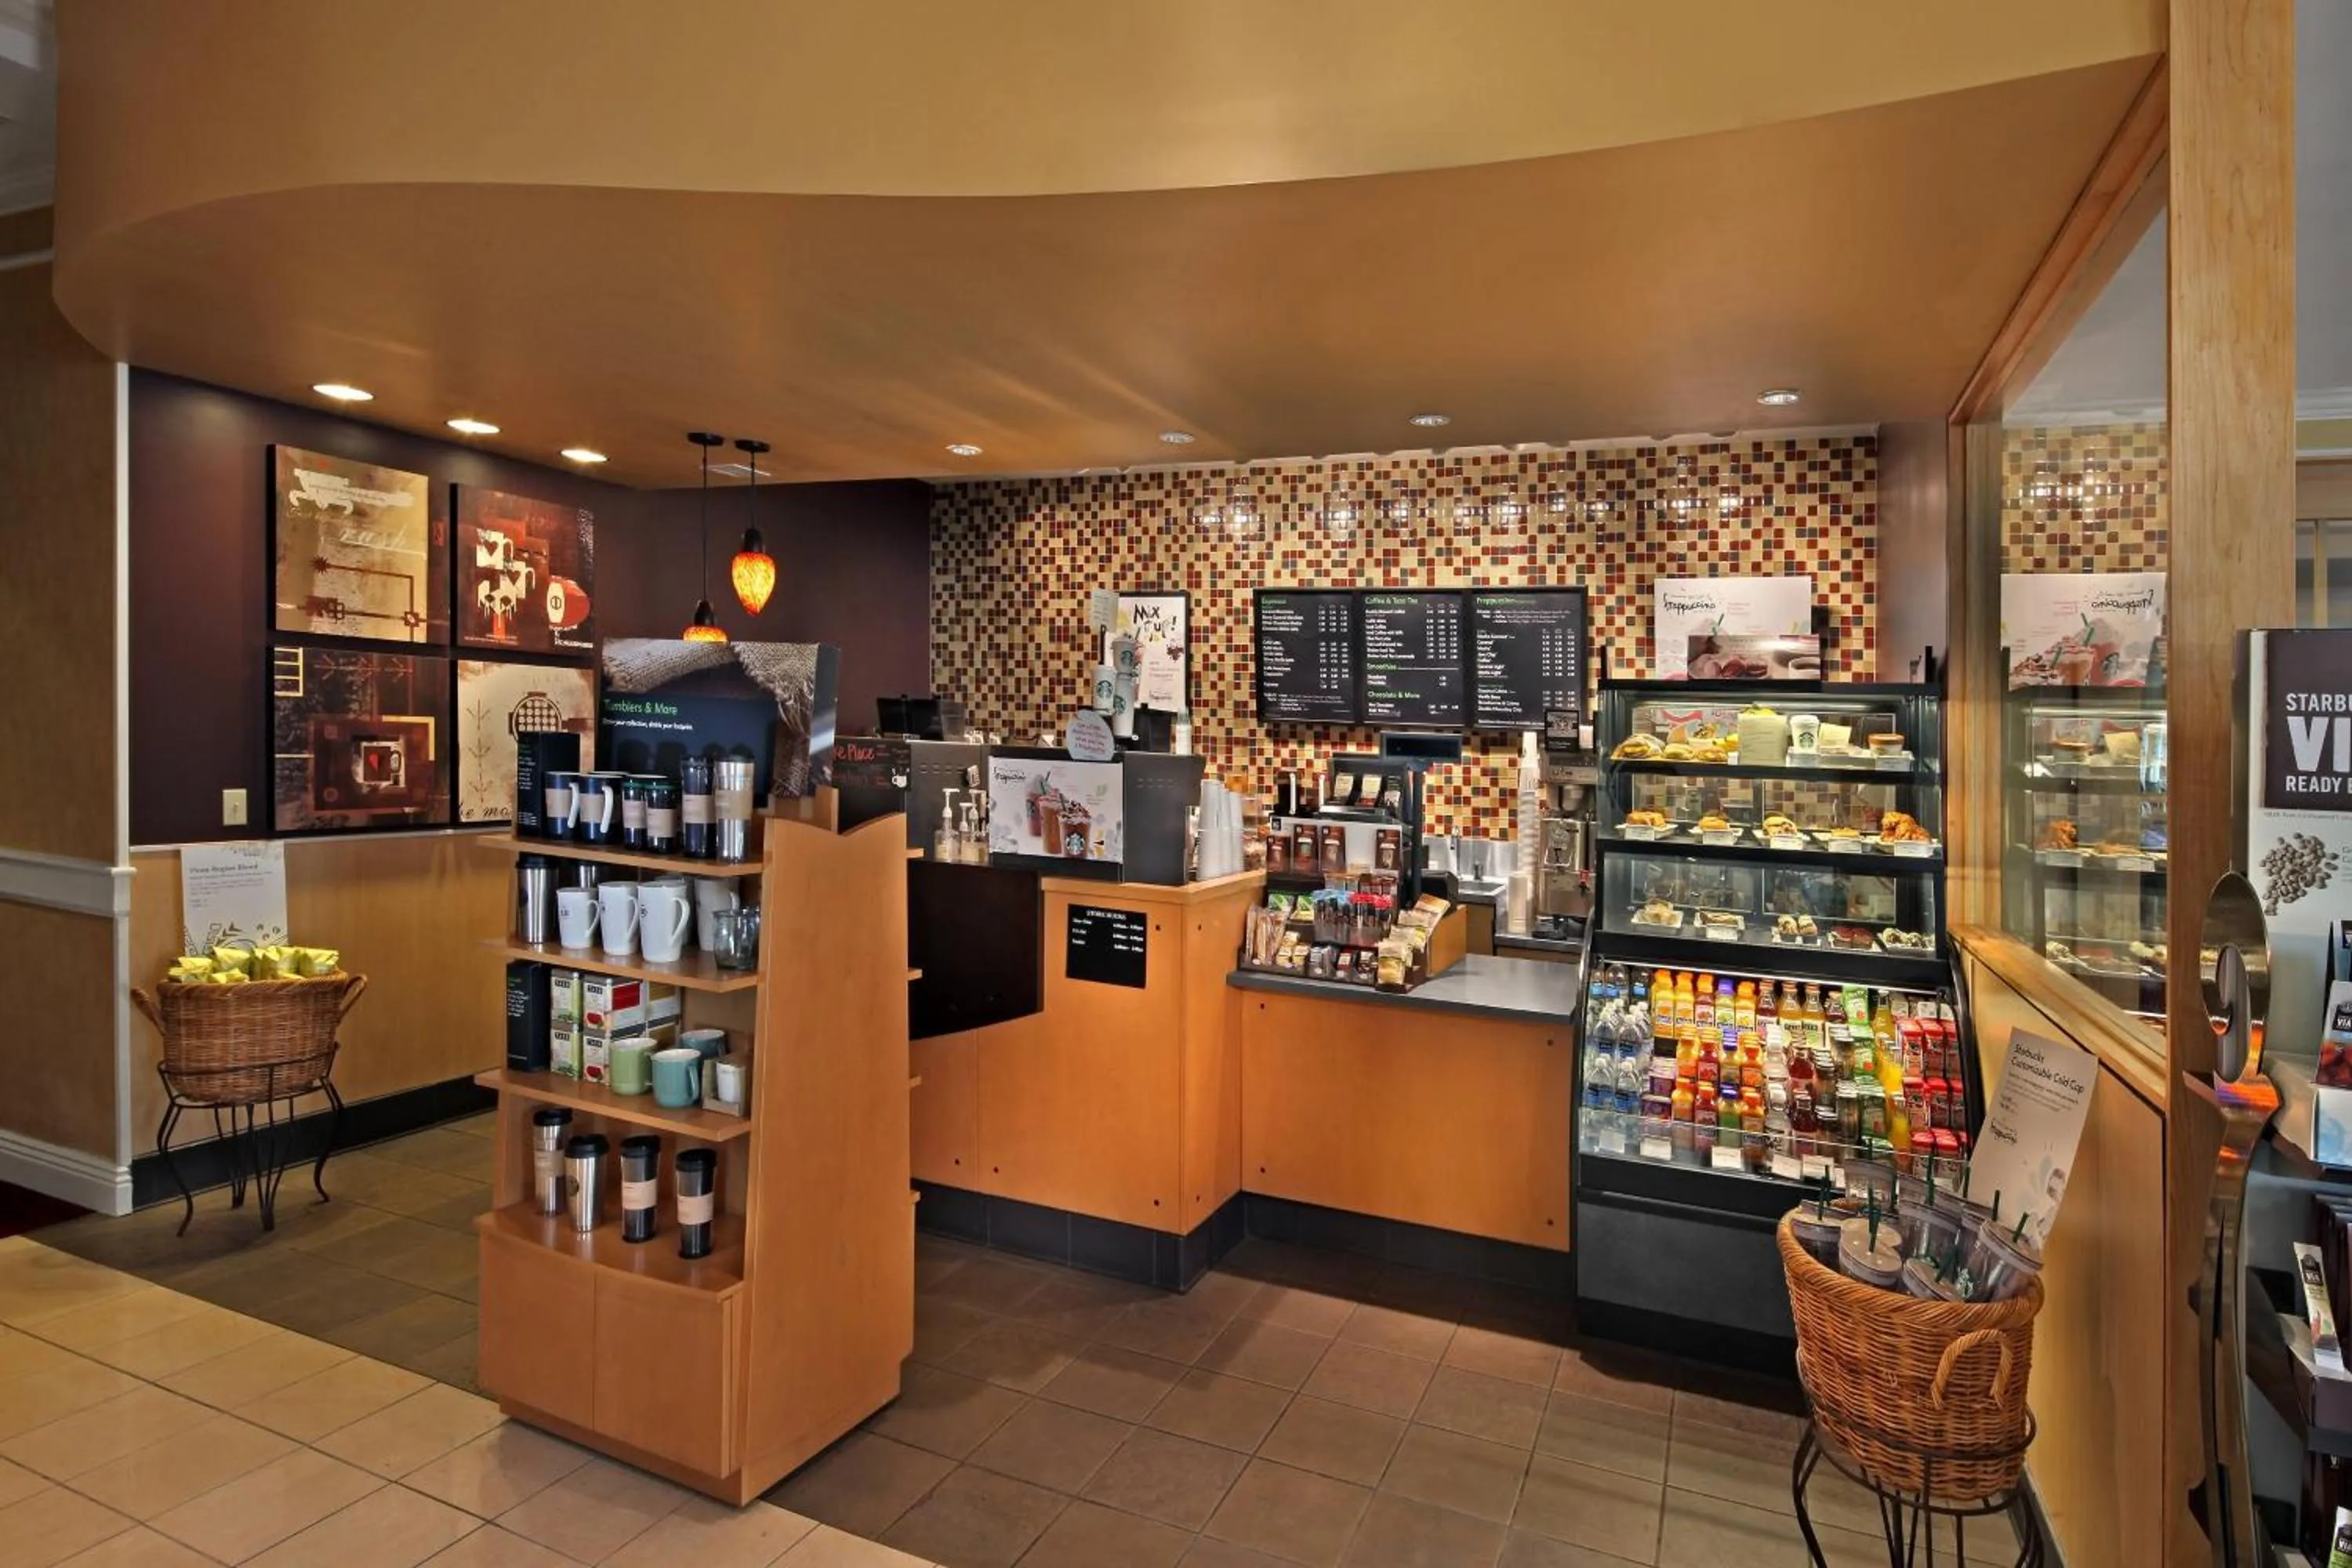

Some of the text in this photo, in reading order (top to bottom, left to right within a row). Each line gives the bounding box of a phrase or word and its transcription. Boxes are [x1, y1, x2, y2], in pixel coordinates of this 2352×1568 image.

[655, 702, 678, 715] More
[2285, 692, 2352, 712] STARB
[2285, 775, 2343, 793] READY
[2014, 1044, 2045, 1063] Starbucks
[2053, 1073, 2070, 1087] Cold
[2070, 1080, 2084, 1094] Cup
